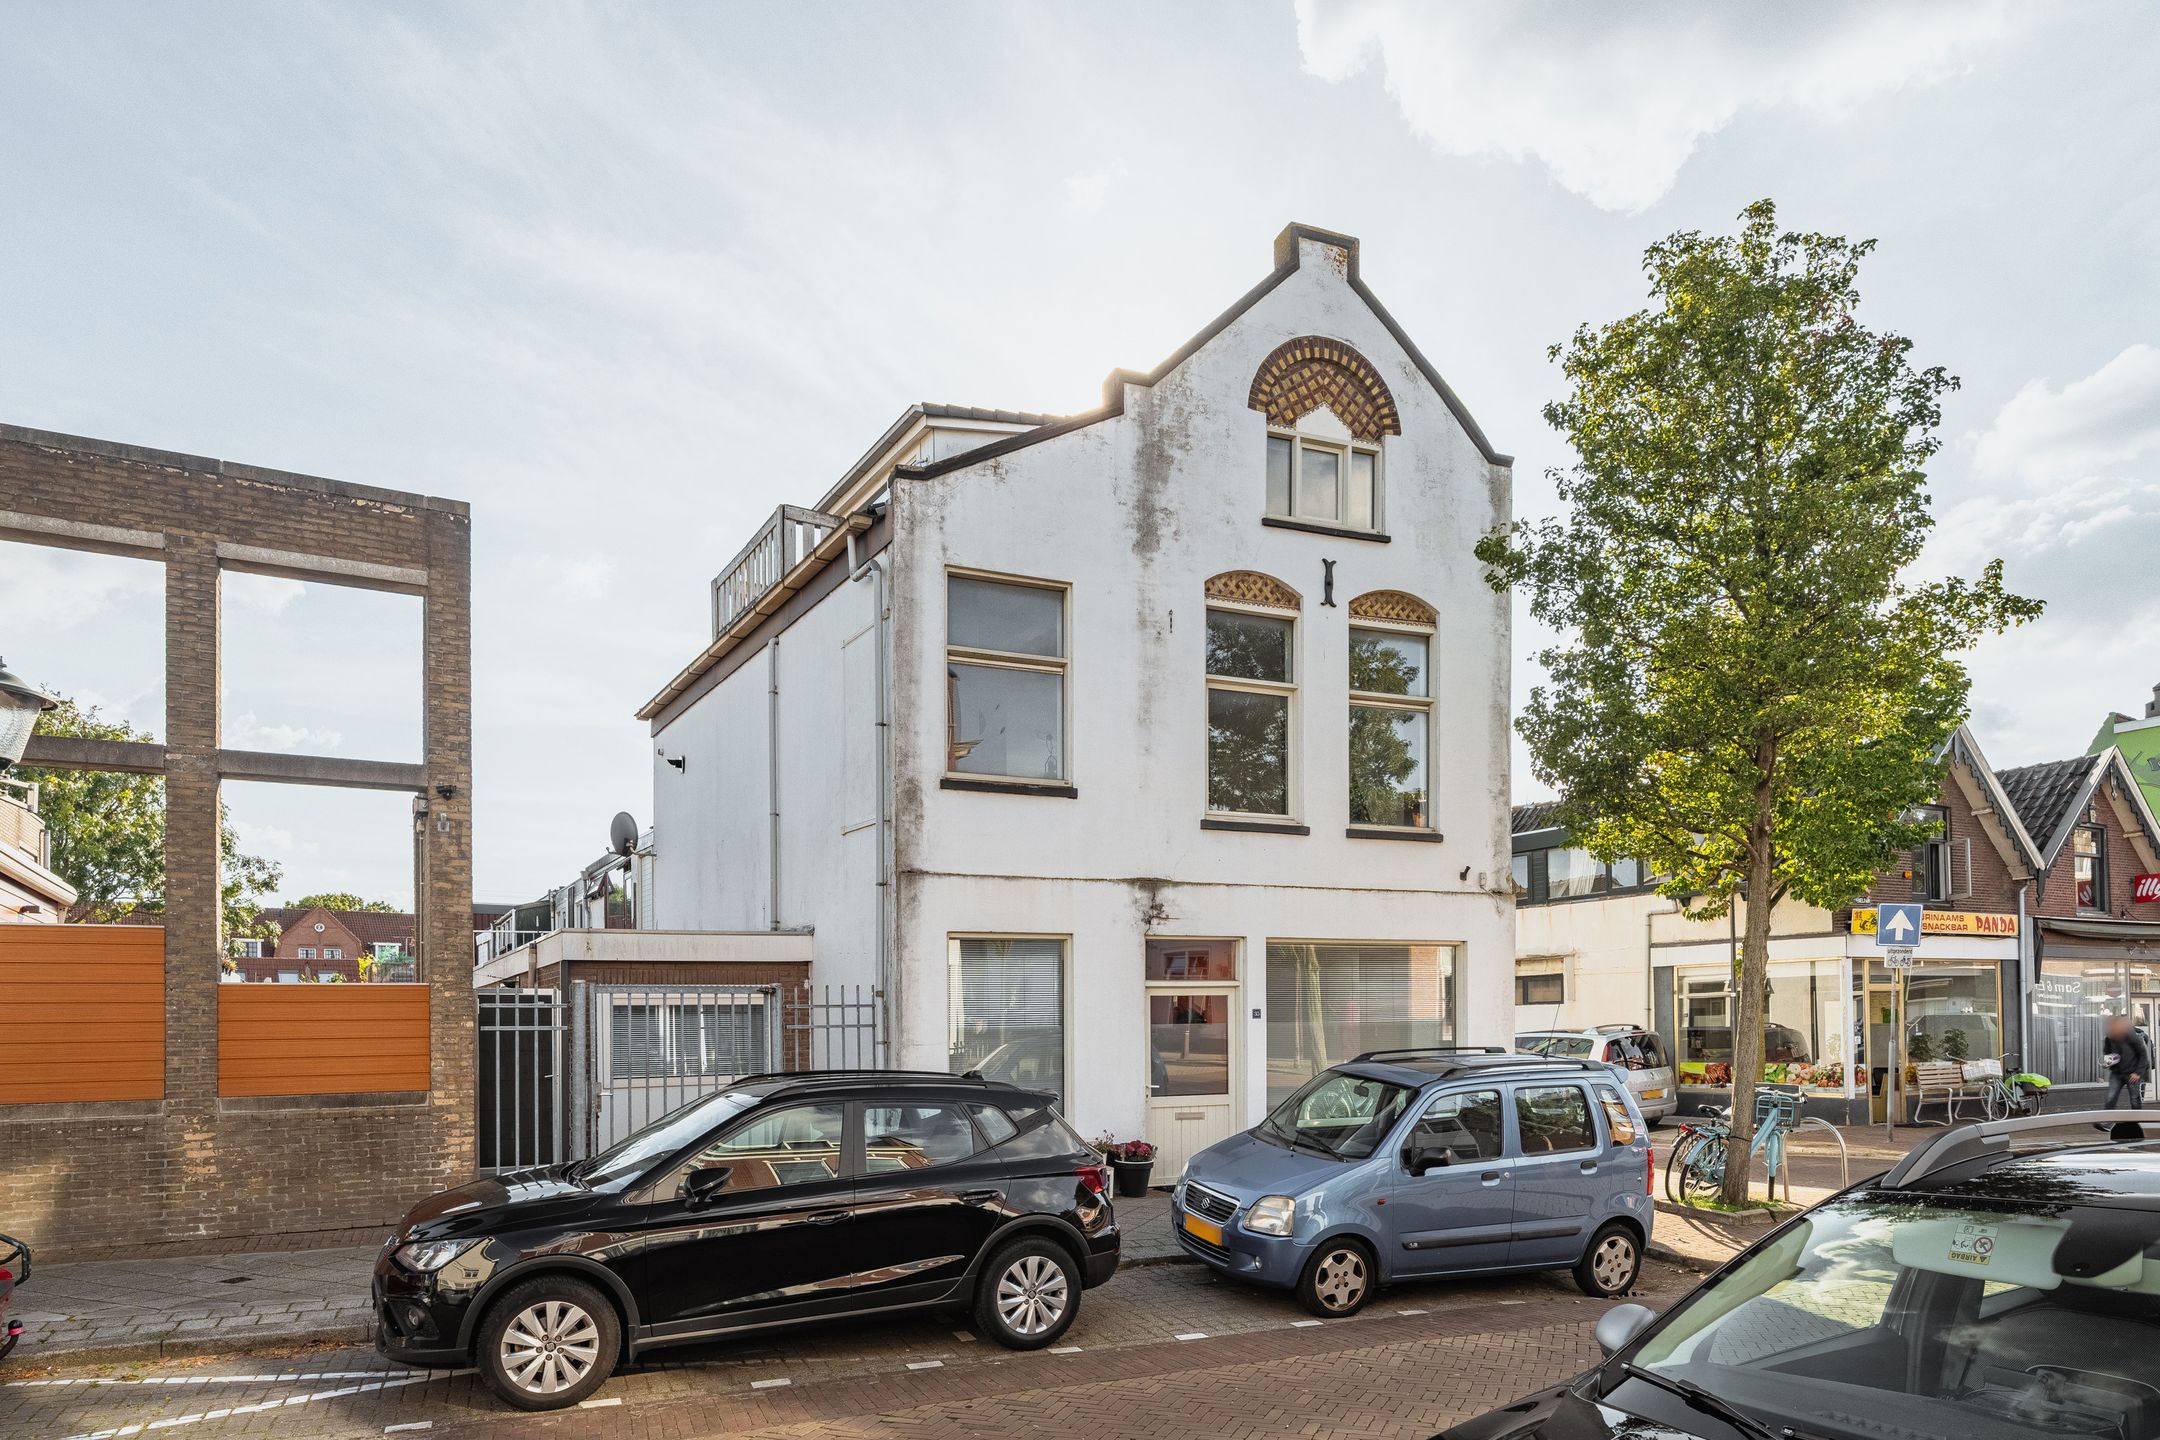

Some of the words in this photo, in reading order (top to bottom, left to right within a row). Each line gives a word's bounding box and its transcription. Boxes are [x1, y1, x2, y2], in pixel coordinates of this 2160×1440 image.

[1922, 922, 1968, 931] SNACKBAR
[1975, 915, 2015, 933] PANDA
[1951, 1252, 1977, 1261] AIRBAG
